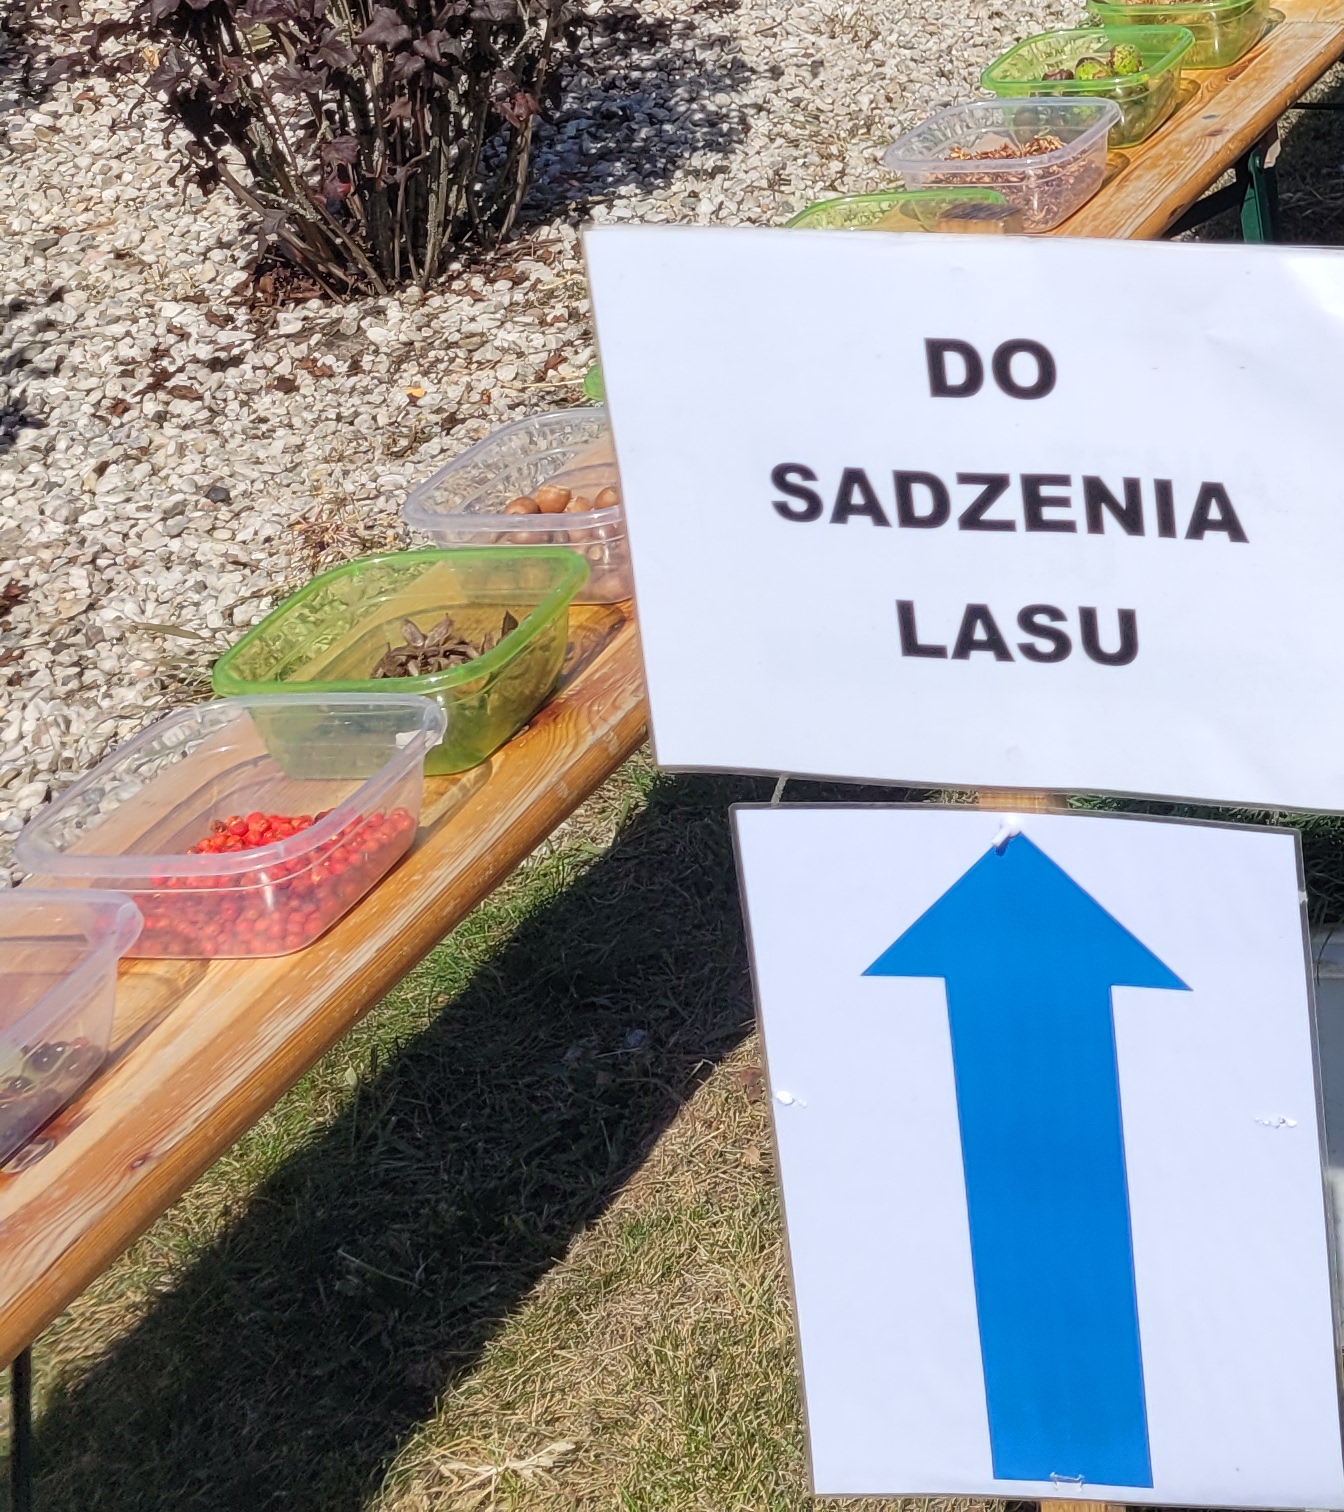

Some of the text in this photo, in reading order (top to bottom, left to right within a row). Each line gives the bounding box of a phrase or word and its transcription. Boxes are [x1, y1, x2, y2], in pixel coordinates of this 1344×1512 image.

[922, 337, 1058, 401] DO
[769, 462, 1251, 545] SADZENIA
[894, 599, 1140, 668] LASU
